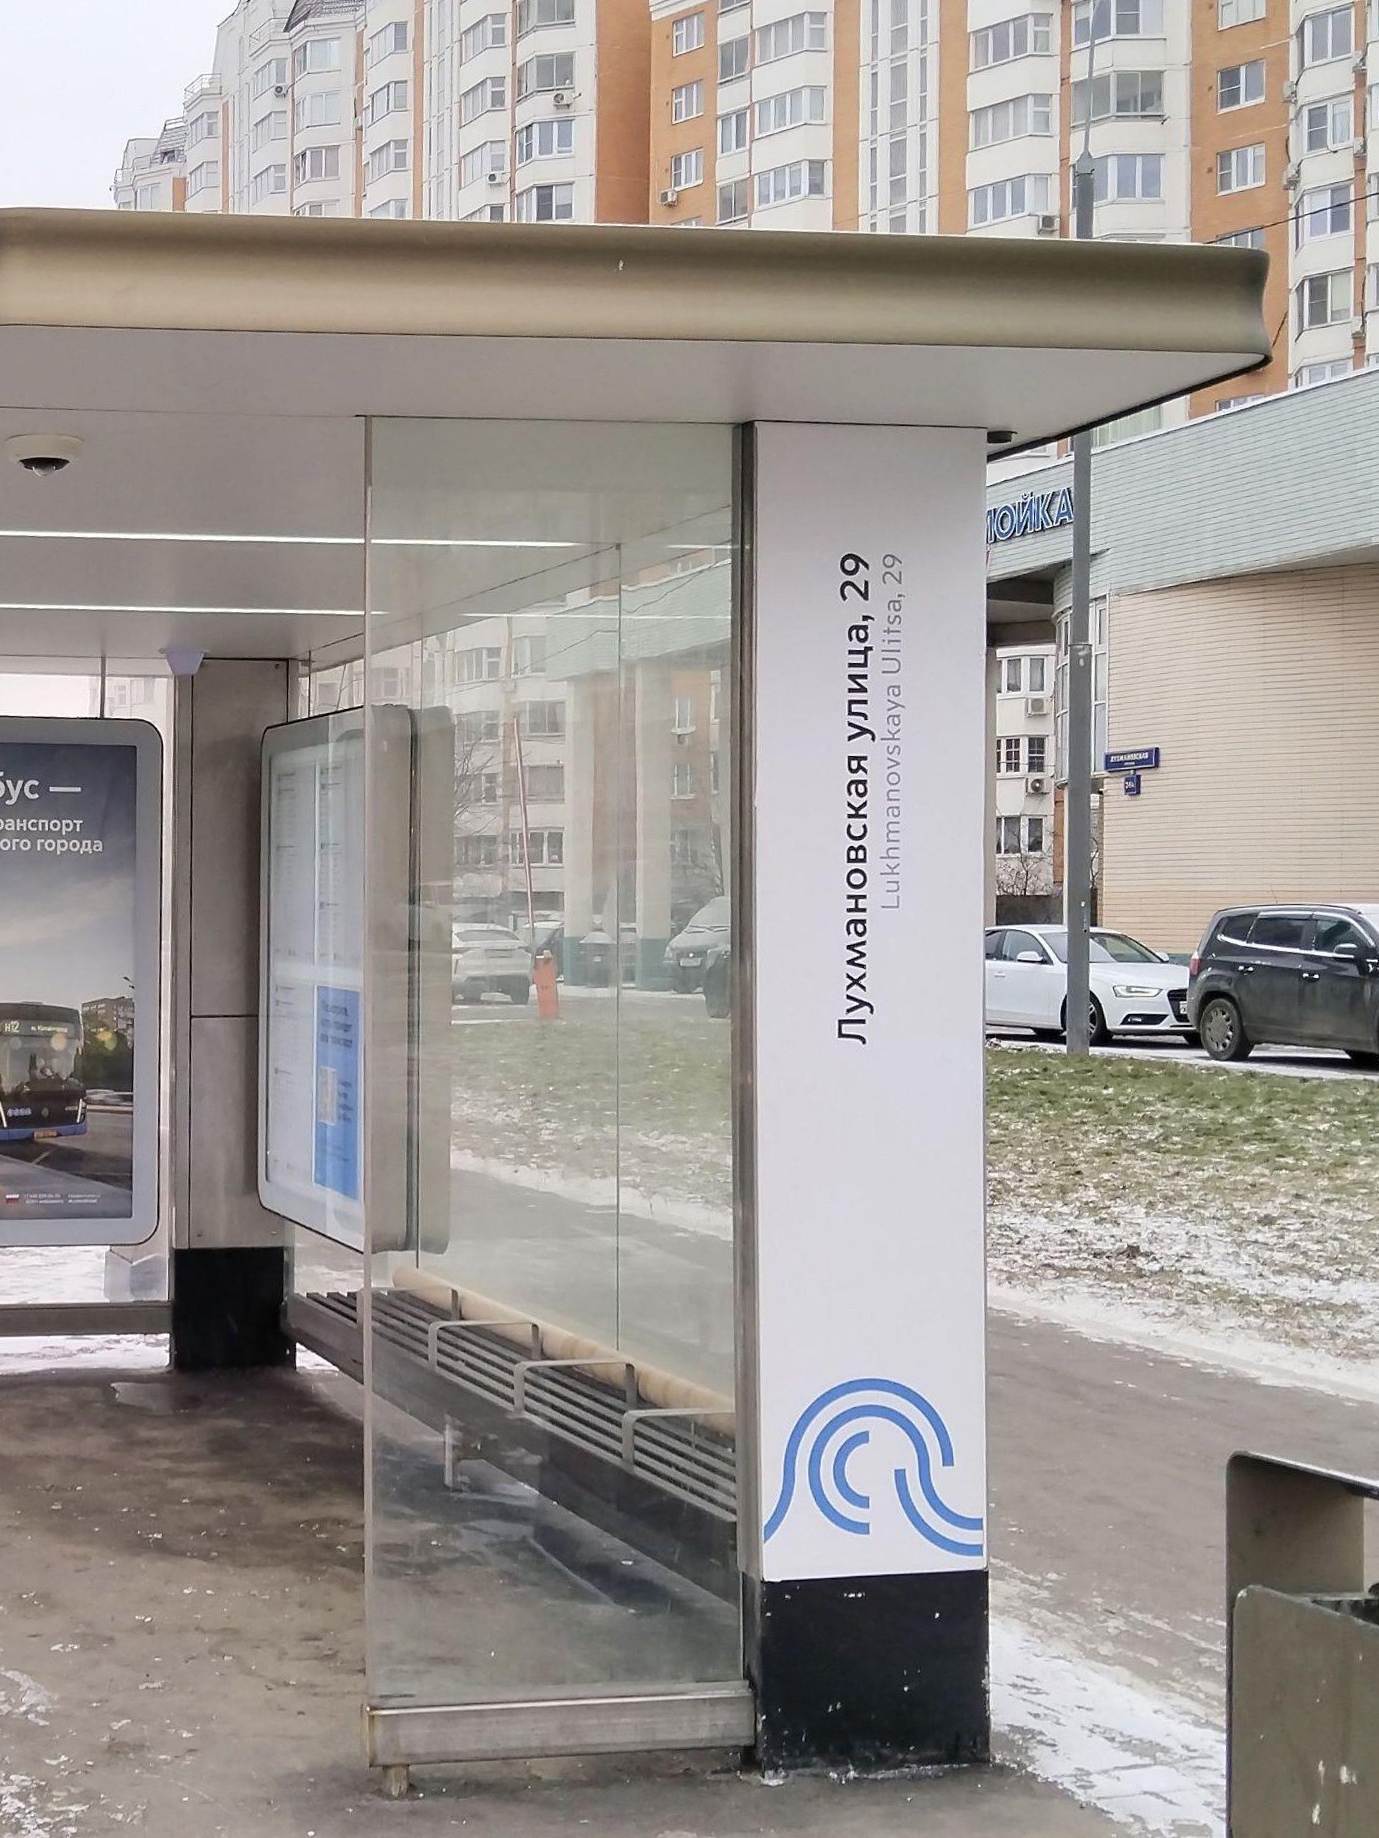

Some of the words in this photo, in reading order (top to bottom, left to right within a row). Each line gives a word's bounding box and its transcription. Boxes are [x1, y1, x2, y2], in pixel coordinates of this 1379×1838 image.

[839, 553, 870, 602] 29
[882, 554, 903, 585] 29
[881, 593, 906, 674] Ulitsa,
[847, 614, 875, 742] улица,
[880, 685, 906, 910] Lukhmanovskaya
[36, 839, 103, 854] города
[838, 755, 874, 1045] Лухмановская
